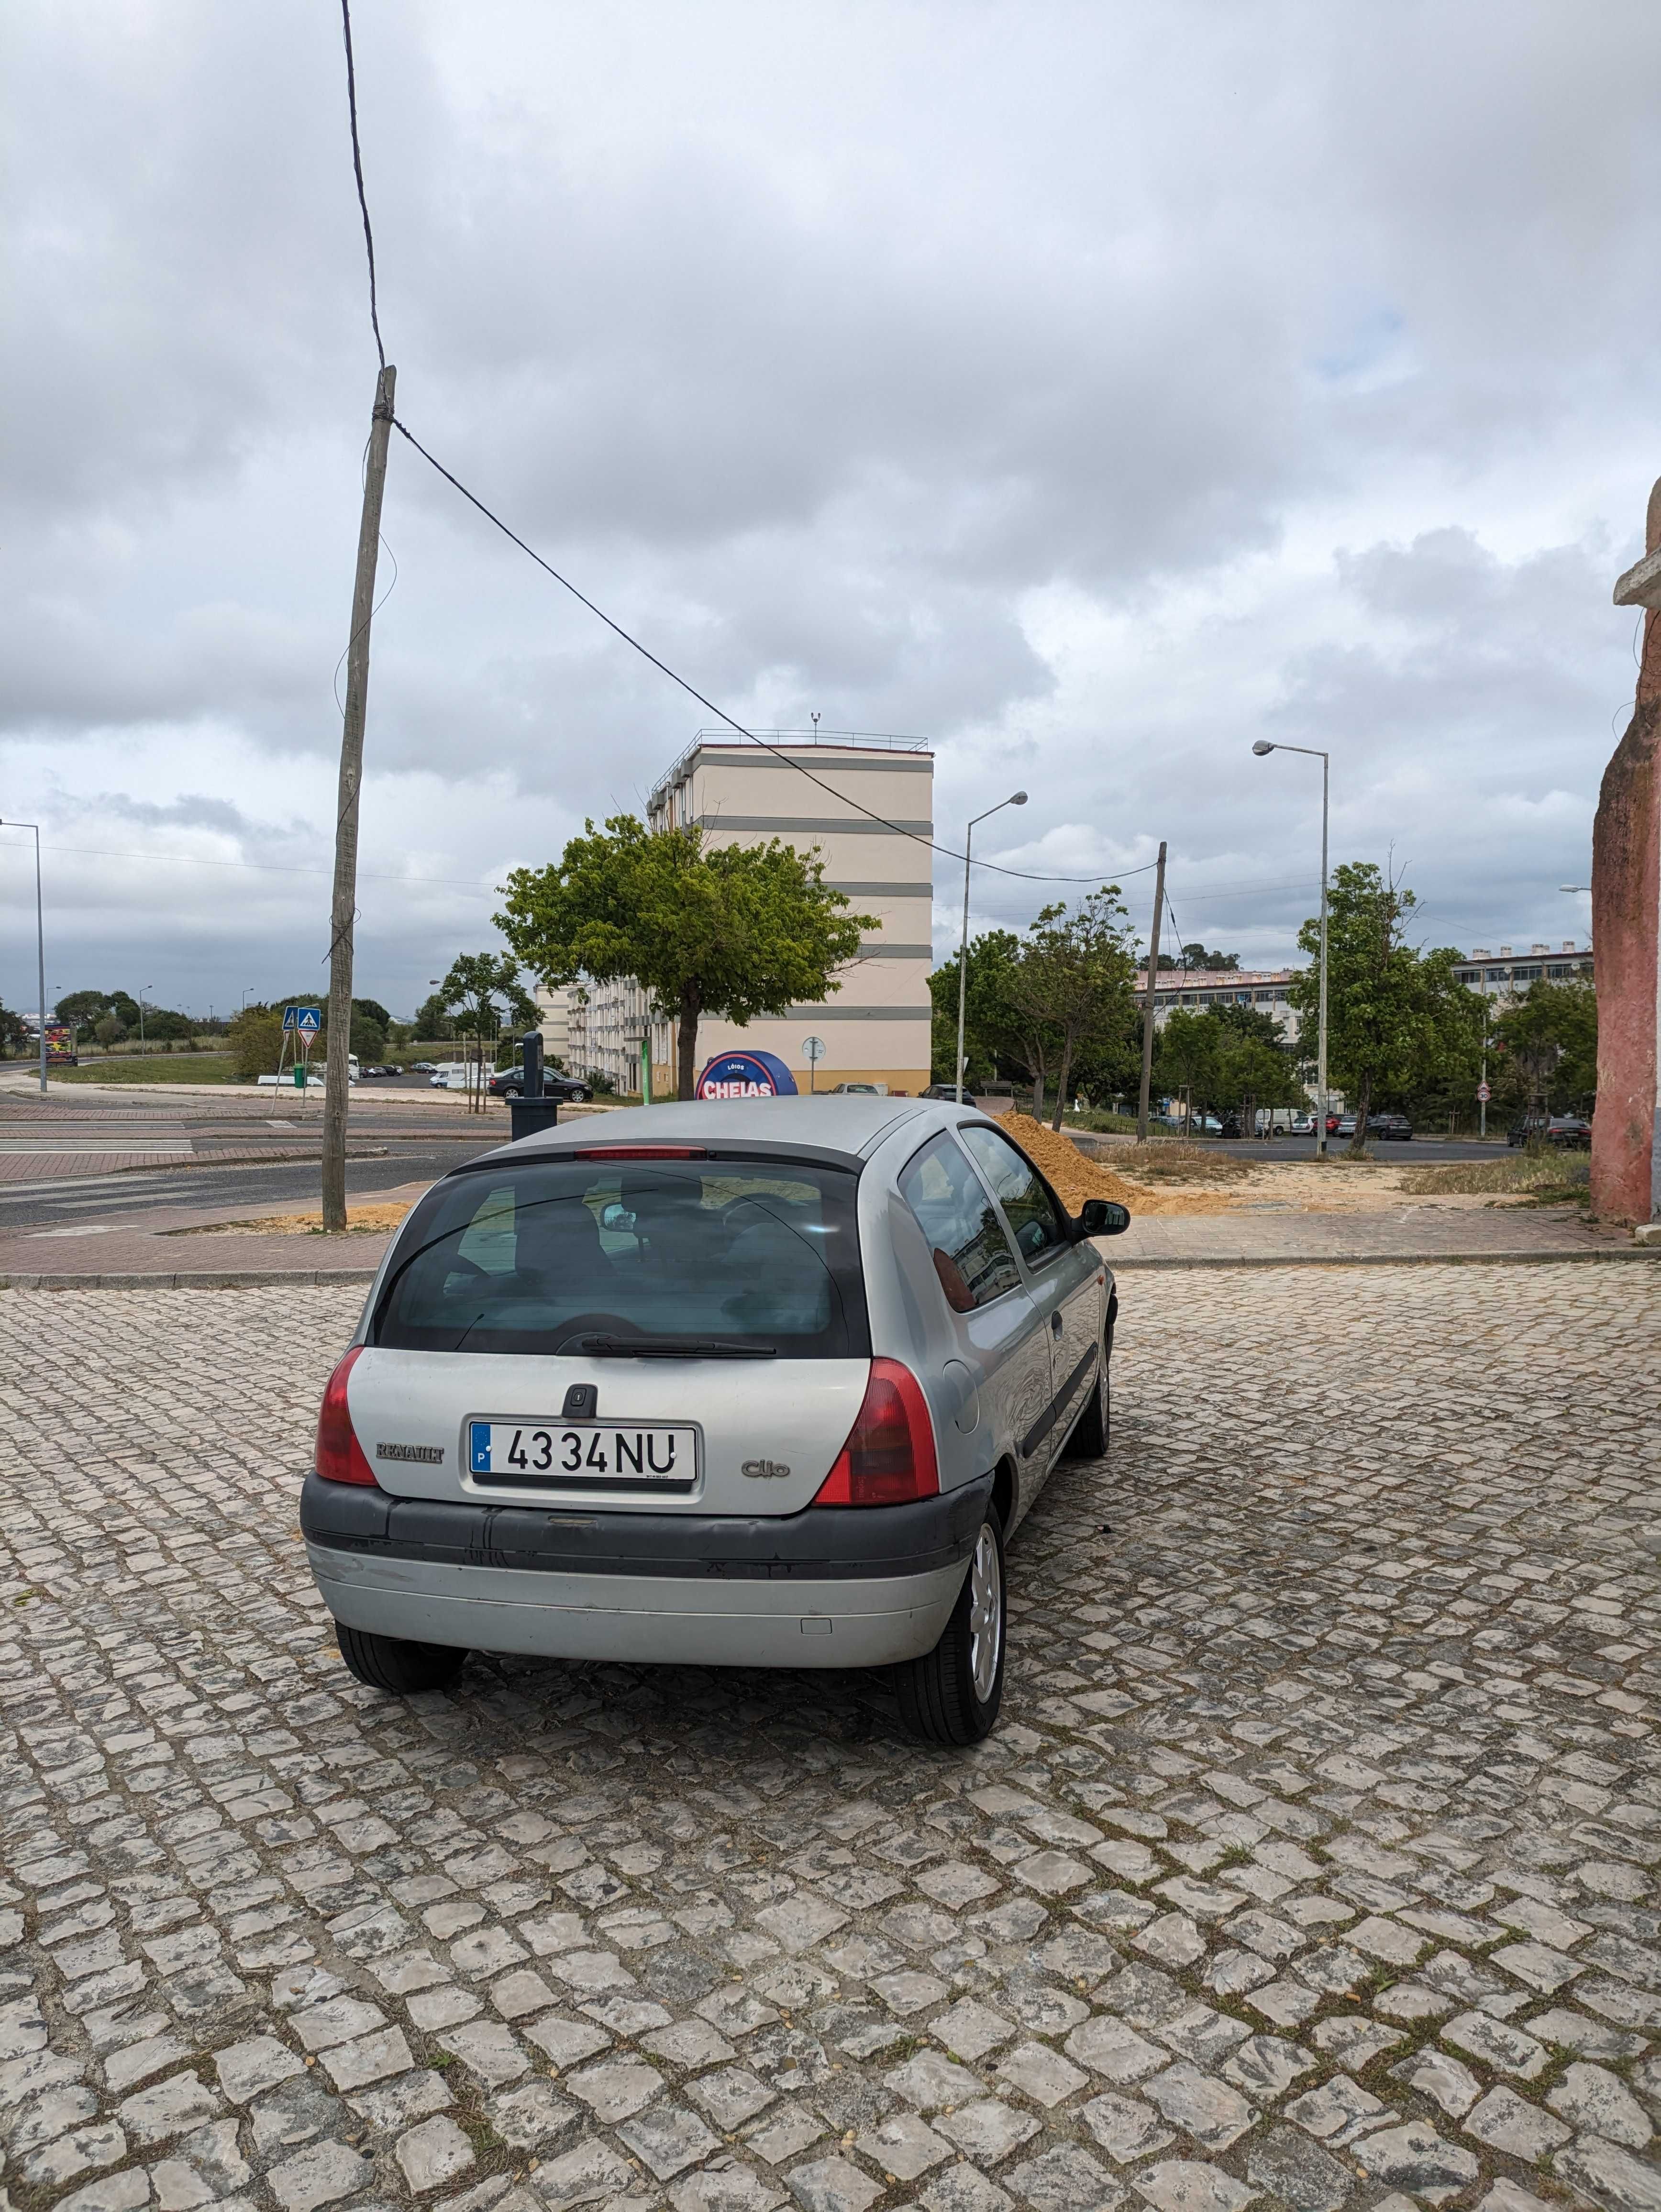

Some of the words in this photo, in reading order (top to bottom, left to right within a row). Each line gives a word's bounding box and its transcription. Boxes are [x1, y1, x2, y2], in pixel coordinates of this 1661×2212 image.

[704, 1080, 772, 1099] CHELAS
[376, 1442, 444, 1464] RENAULT
[478, 1452, 485, 1463] P
